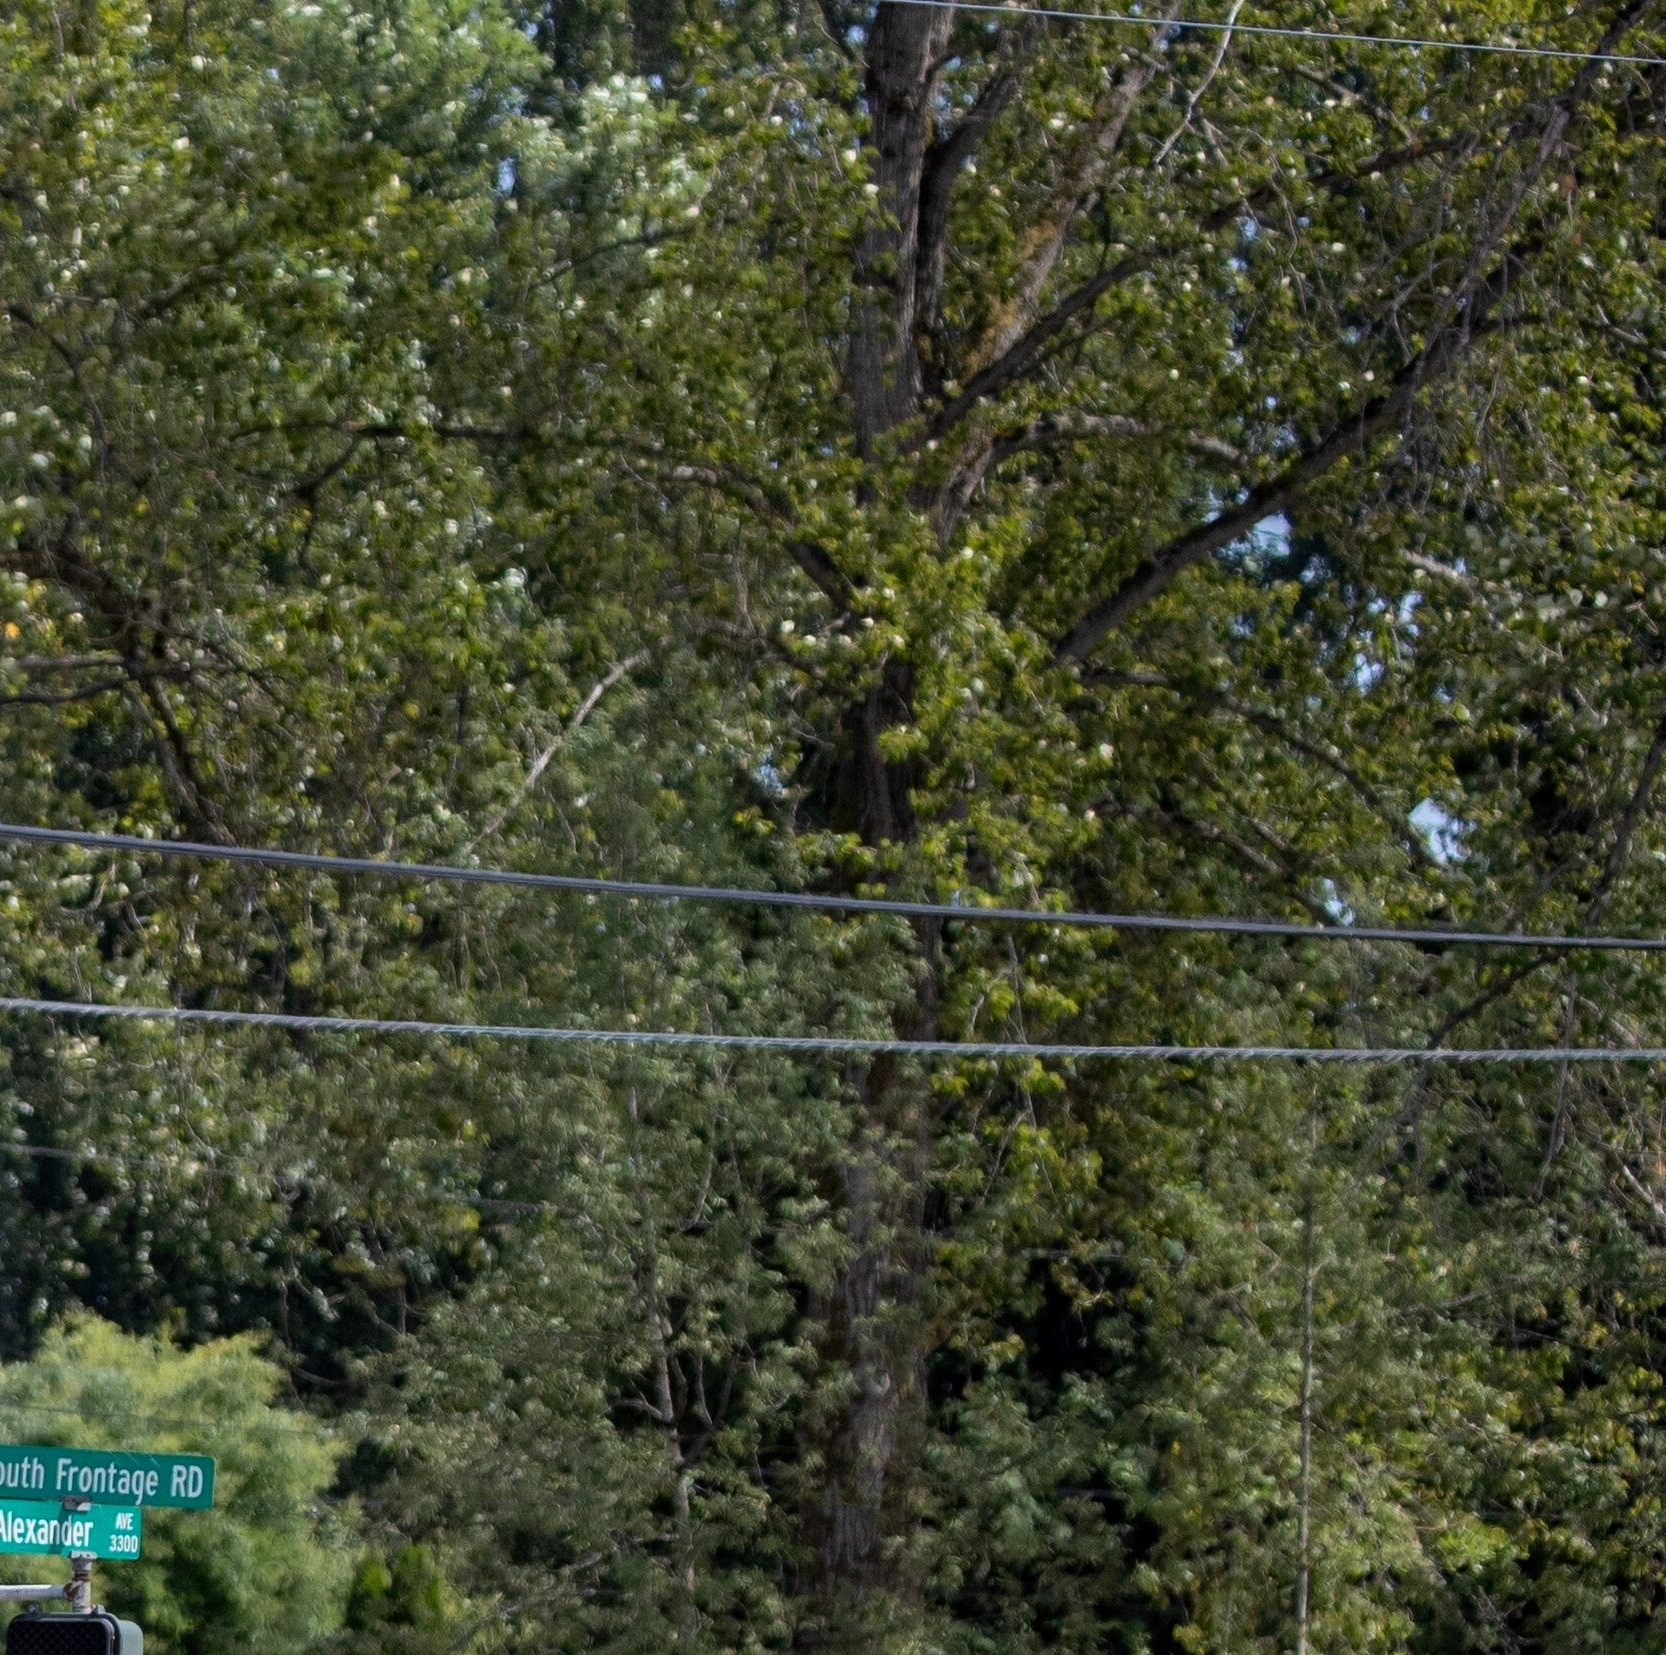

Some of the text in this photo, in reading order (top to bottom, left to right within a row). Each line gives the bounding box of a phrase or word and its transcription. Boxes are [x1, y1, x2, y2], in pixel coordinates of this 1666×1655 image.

[55, 1457, 159, 1506] Frontage
[170, 1464, 204, 1499] RD
[115, 1512, 135, 1531] AVE
[108, 1534, 139, 1553] 3300
